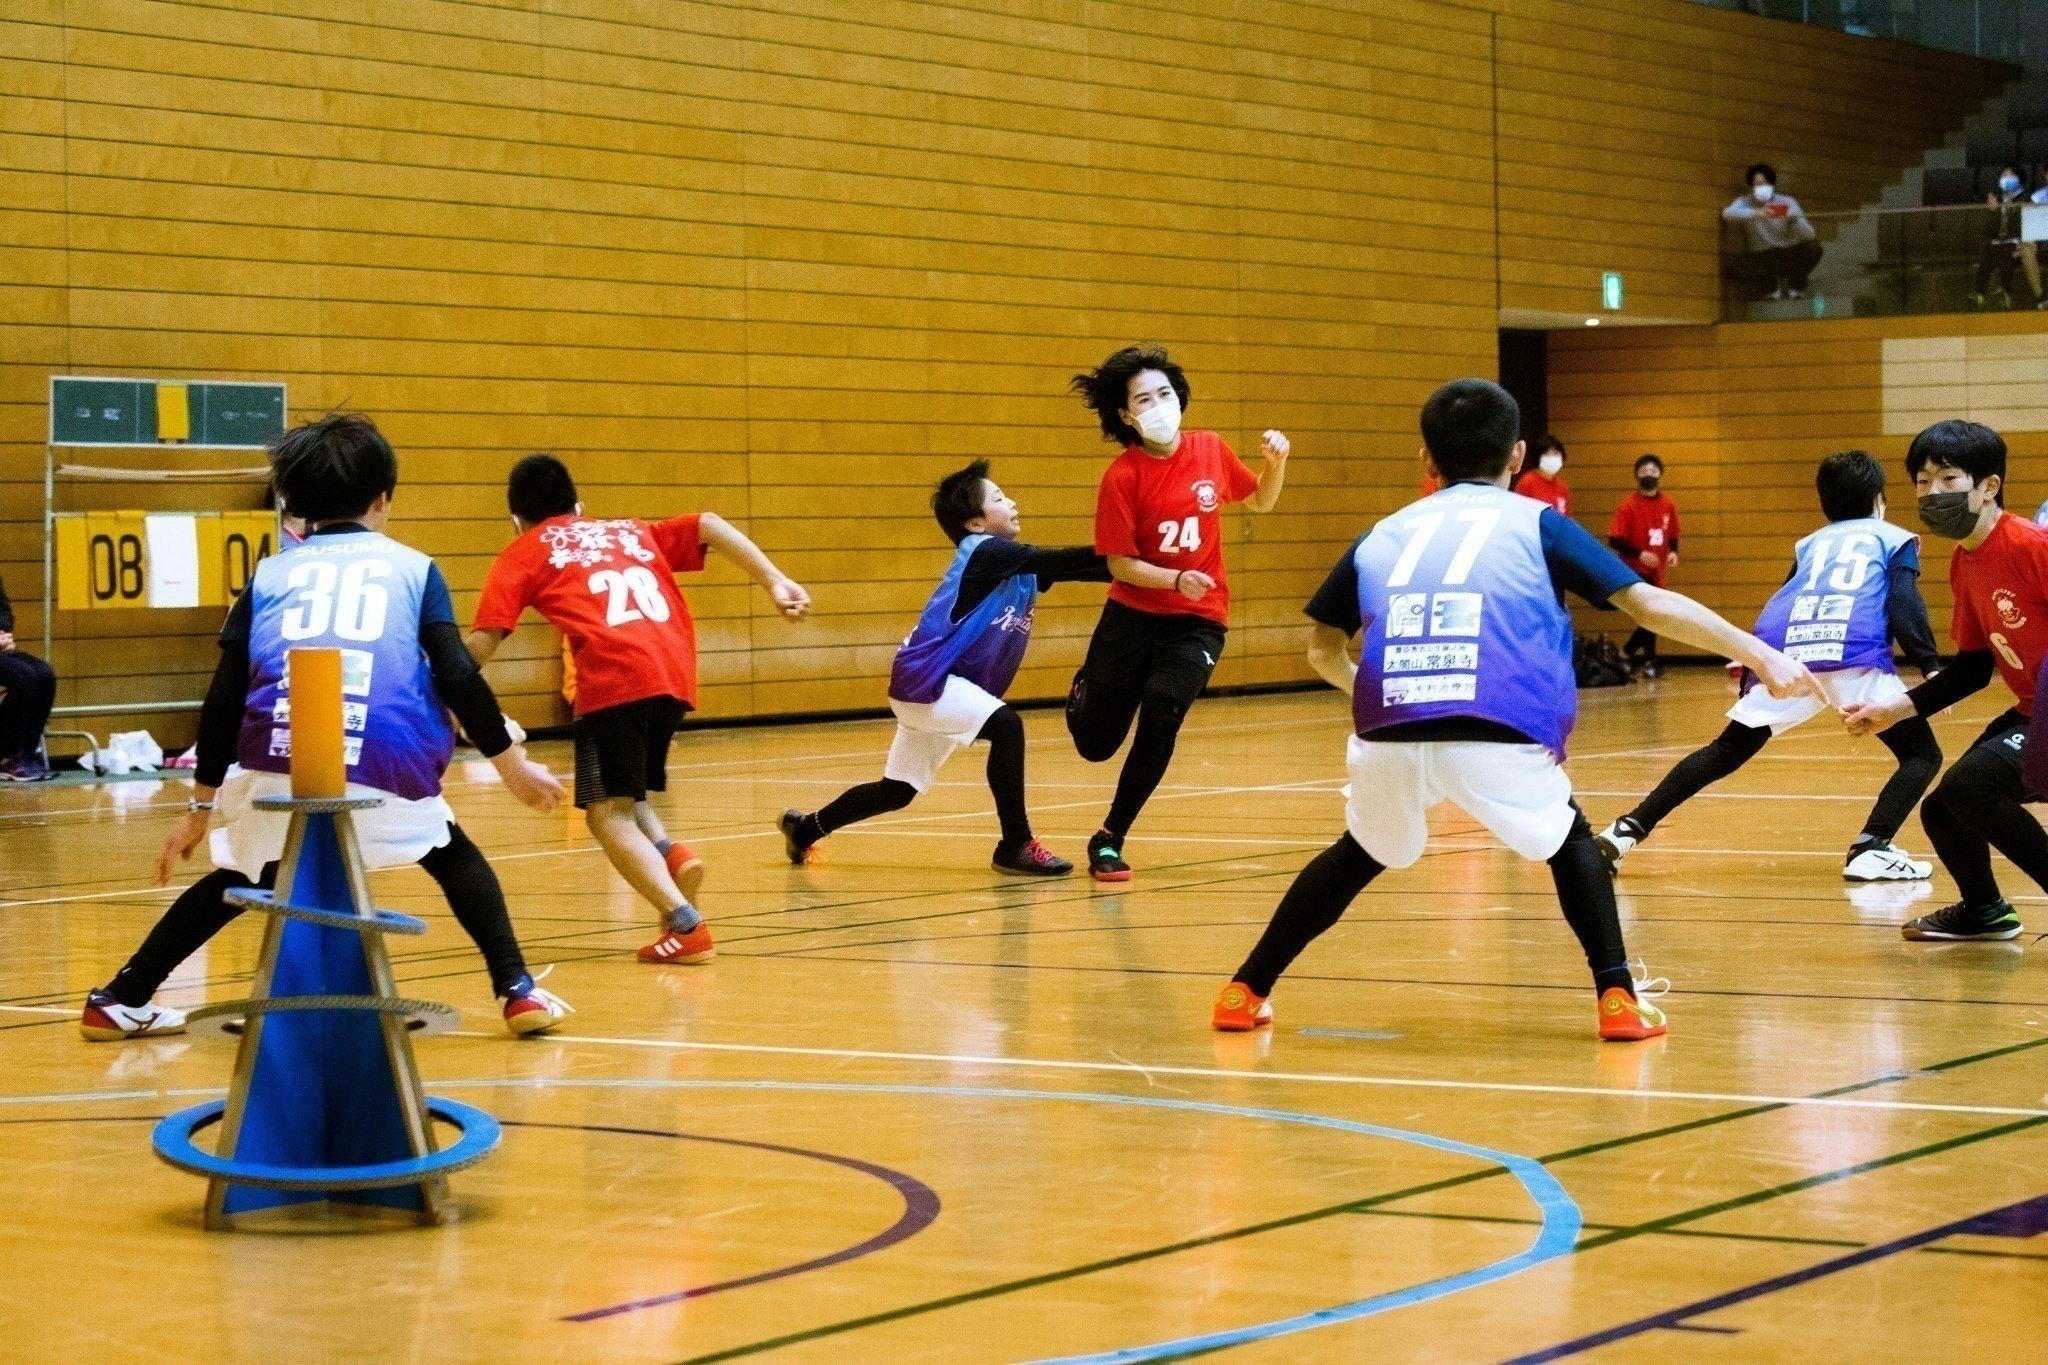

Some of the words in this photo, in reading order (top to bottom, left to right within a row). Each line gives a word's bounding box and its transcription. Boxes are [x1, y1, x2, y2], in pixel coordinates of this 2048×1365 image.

[294, 540, 397, 558] SUSUMU
[1158, 515, 1202, 554] 24
[1386, 507, 1503, 588] 77
[1802, 533, 1875, 591] 15
[91, 533, 144, 601] 08
[587, 566, 671, 628] 28
[281, 558, 393, 642] 36
[1990, 632, 2024, 670] 6
